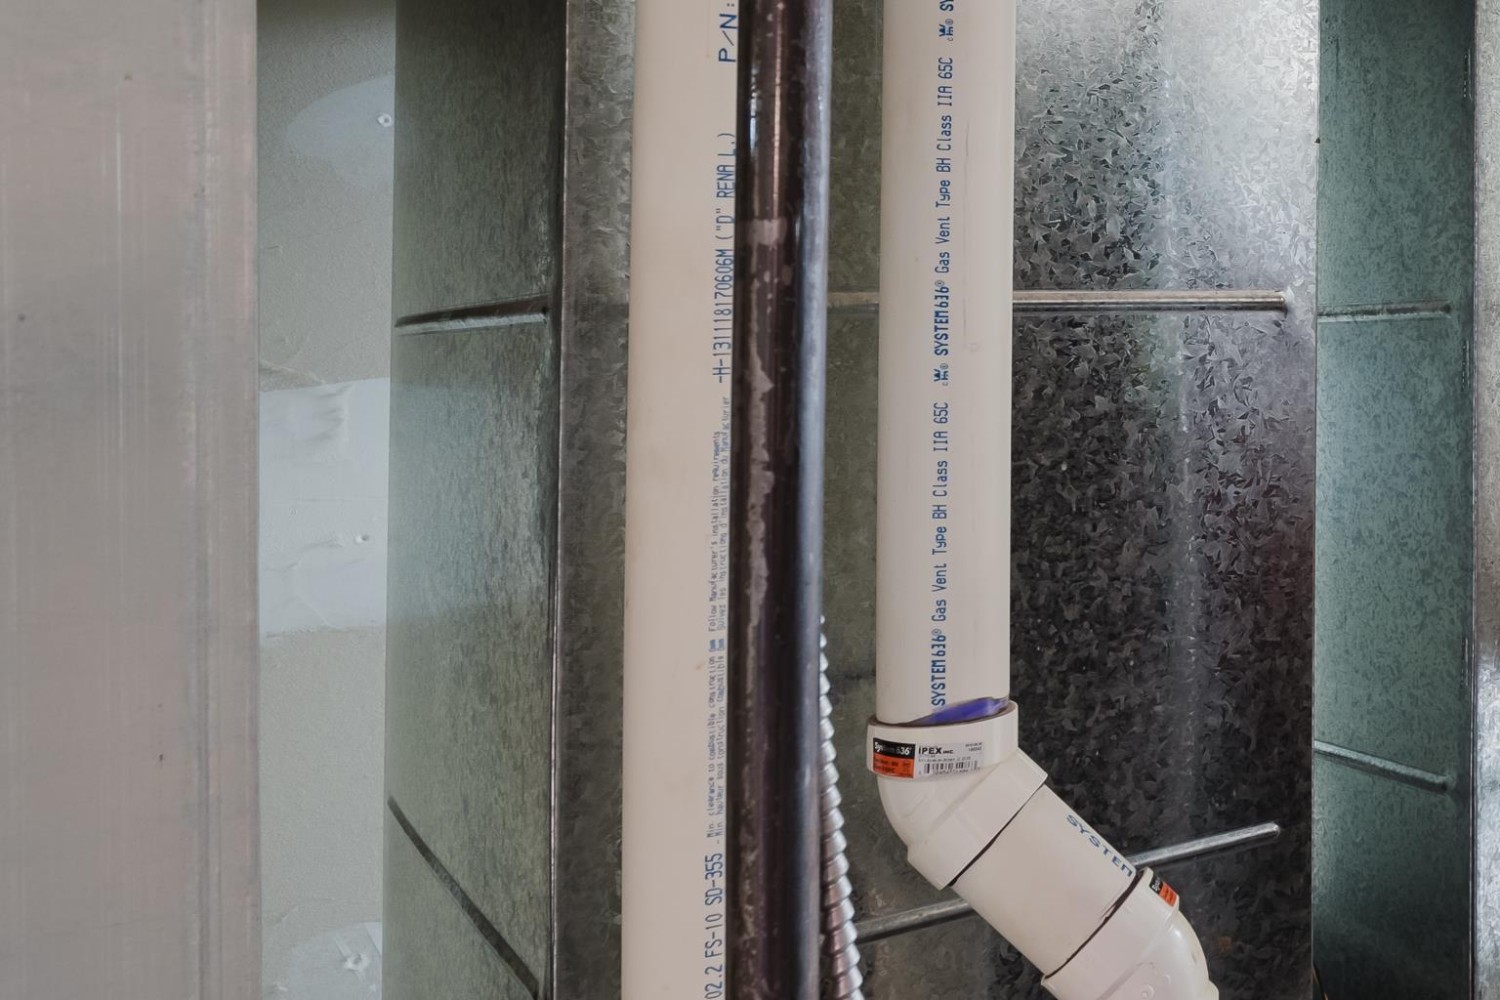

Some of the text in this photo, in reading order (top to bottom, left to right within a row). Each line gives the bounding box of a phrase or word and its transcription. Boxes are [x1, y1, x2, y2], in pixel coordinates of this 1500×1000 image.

[938, 57, 953, 79] 65C
[937, 86, 952, 106] IIA
[937, 115, 951, 151] Class
[936, 158, 951, 172] BH
[716, 165, 734, 198] RENA
[936, 180, 950, 207] Type
[936, 217, 950, 244] Vent
[935, 252, 949, 273] Gas
[934, 311, 948, 355] SYSTEM
[933, 403, 948, 424] 65C
[933, 431, 948, 451] IIA
[933, 461, 948, 496] Class
[932, 505, 947, 519] BH
[932, 527, 947, 555] Type
[932, 563, 946, 592] Vent
[707, 606, 716, 631] Follow
[931, 599, 946, 621] Gas
[931, 659, 945, 706] SYSTEM
[705, 853, 723, 905] SD-355
[705, 914, 722, 958] FS-10
